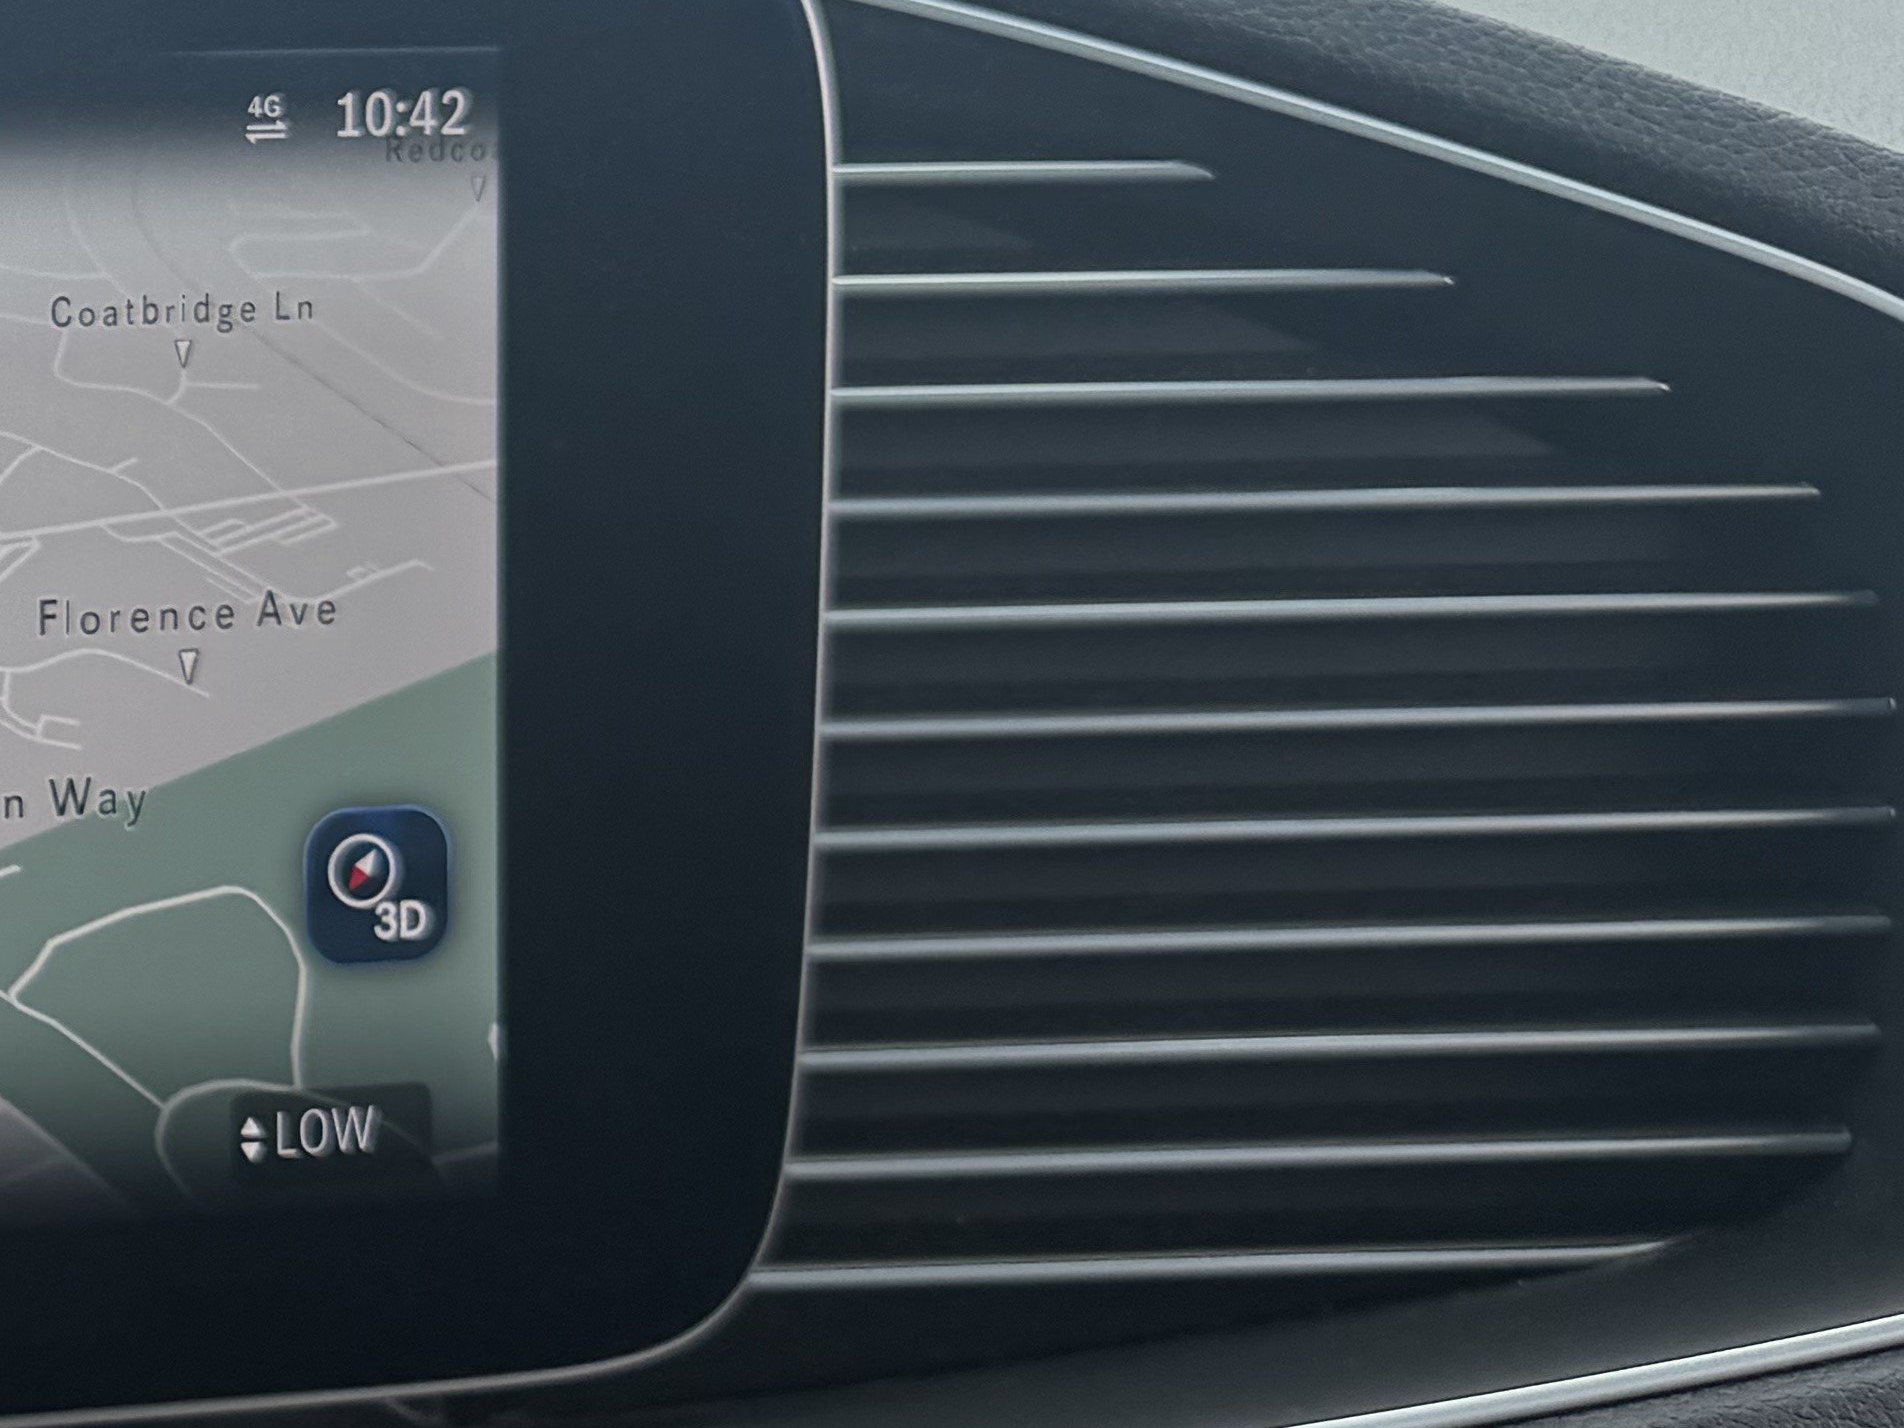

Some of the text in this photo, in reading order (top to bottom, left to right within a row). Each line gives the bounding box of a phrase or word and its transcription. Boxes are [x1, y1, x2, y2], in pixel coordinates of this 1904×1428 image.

[247, 96, 282, 118] 4G
[336, 90, 468, 138] 10:42
[51, 291, 315, 331] Coatbridge Ln
[38, 594, 337, 637] Florence Ave
[51, 778, 148, 829] Way
[375, 903, 426, 940] 3D
[274, 1106, 381, 1158] LOW
